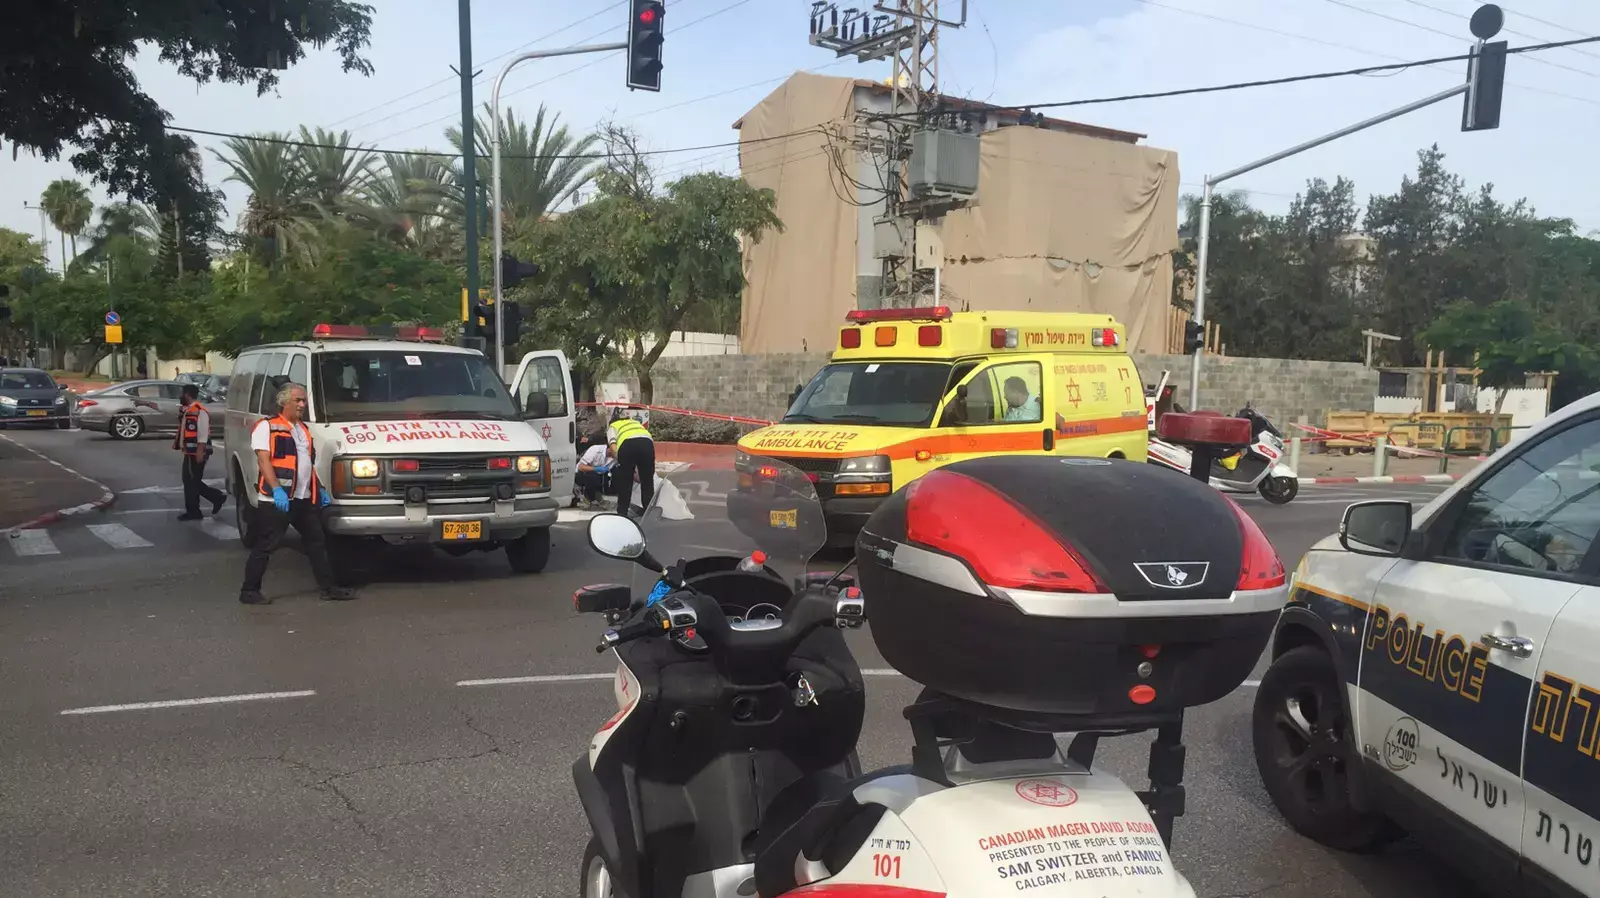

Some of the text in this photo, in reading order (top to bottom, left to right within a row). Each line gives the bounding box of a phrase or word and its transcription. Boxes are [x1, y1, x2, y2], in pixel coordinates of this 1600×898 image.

[1025, 328, 1085, 347] ניידת טיפול נמרץ
[375, 421, 502, 432] מגן דוד אדום
[386, 430, 510, 443] AMBULANCE
[804, 430, 828, 438] דוד
[831, 431, 858, 440] מגן
[345, 431, 376, 444] 690
[755, 438, 848, 451] AMBULANCE
[1367, 603, 1490, 702] POLICE
[1532, 670, 1600, 761] רה
[1397, 728, 1415, 749] 100
[1386, 740, 1417, 765] בשבילך
[1436, 747, 1600, 869] טרת ישראל
[871, 838, 884, 848] חייג
[979, 821, 1156, 851] CANADIAN MAGEN DAVID ADOM
[989, 836, 1160, 862] PRESENTED TO THE PEOPLE OF ISRAEL
[873, 853, 901, 879] 101
[997, 849, 1164, 879] SAM SWITZER and FAMILY
[1074, 866, 1123, 881] ALBERTA,
[1123, 865, 1164, 876] CANADA
